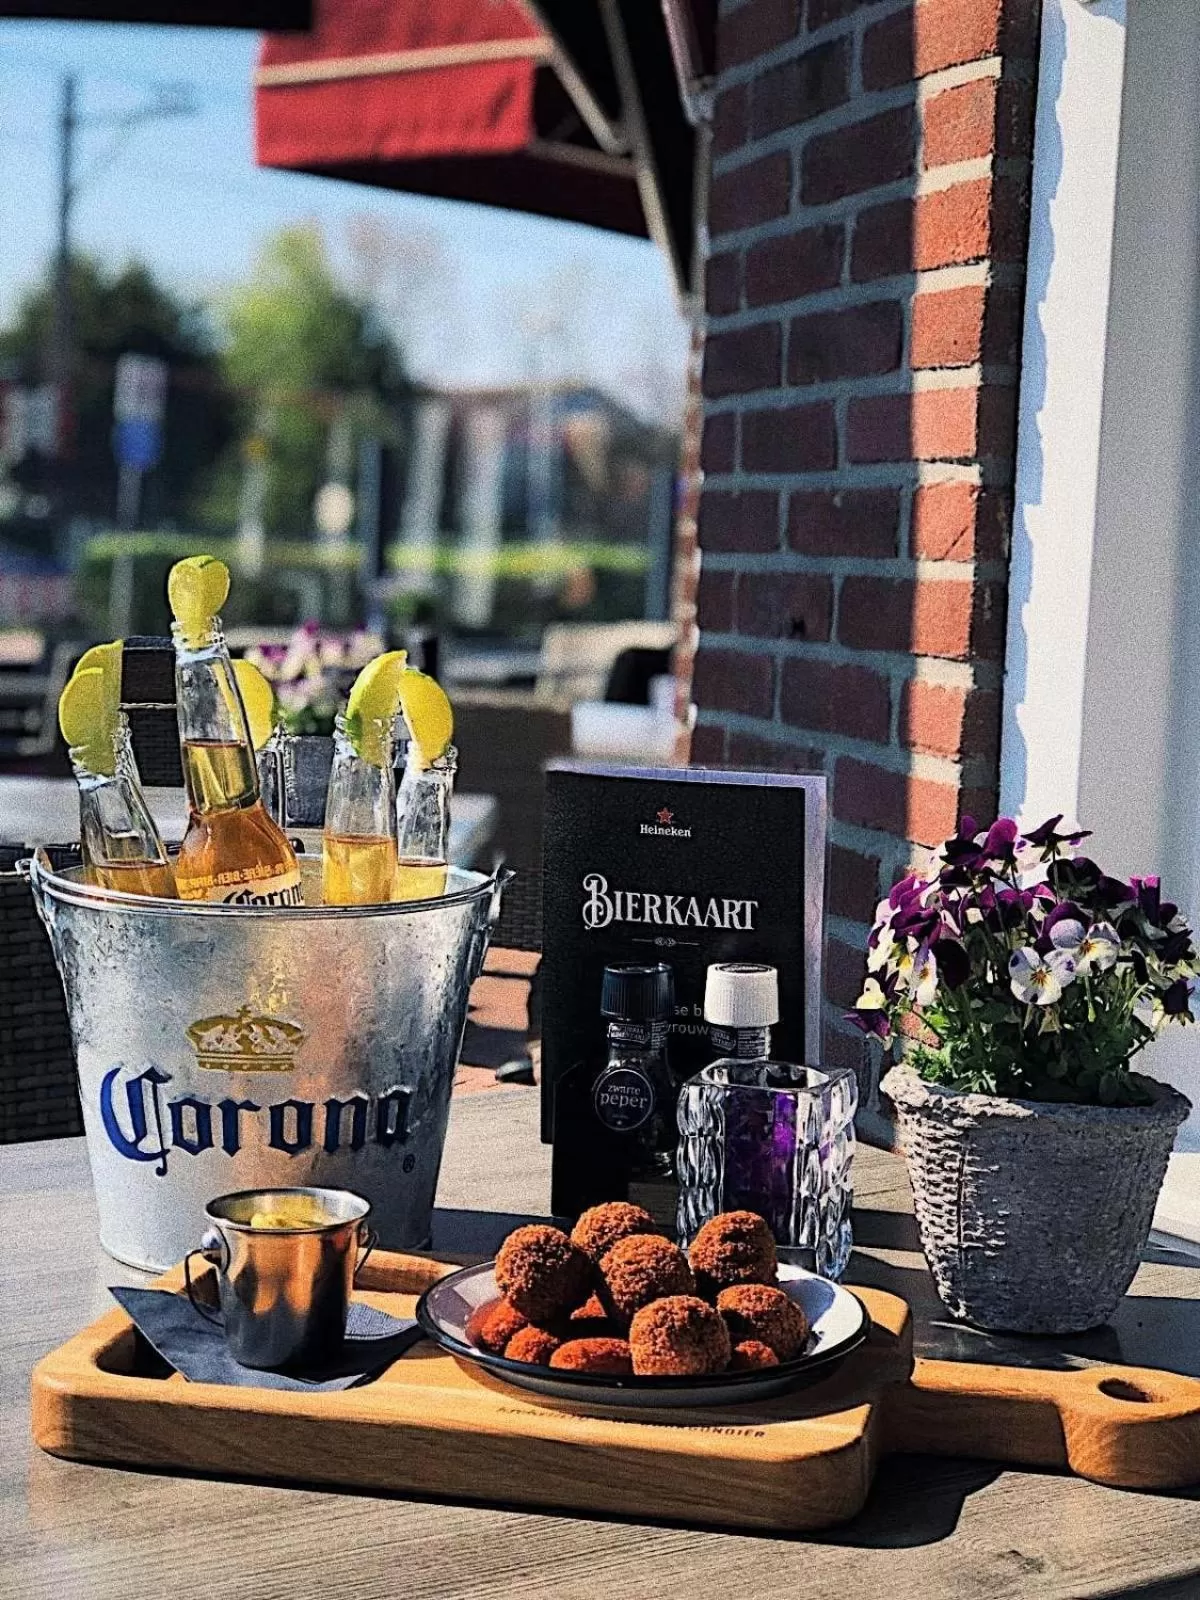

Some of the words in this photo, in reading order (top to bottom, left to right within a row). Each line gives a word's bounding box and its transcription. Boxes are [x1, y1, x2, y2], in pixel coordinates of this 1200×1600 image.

[640, 823, 692, 838] Heineken
[222, 881, 304, 905] Coron
[582, 872, 758, 930] BIERKAART
[600, 1092, 648, 1109] peper
[100, 1065, 414, 1177] Corona
